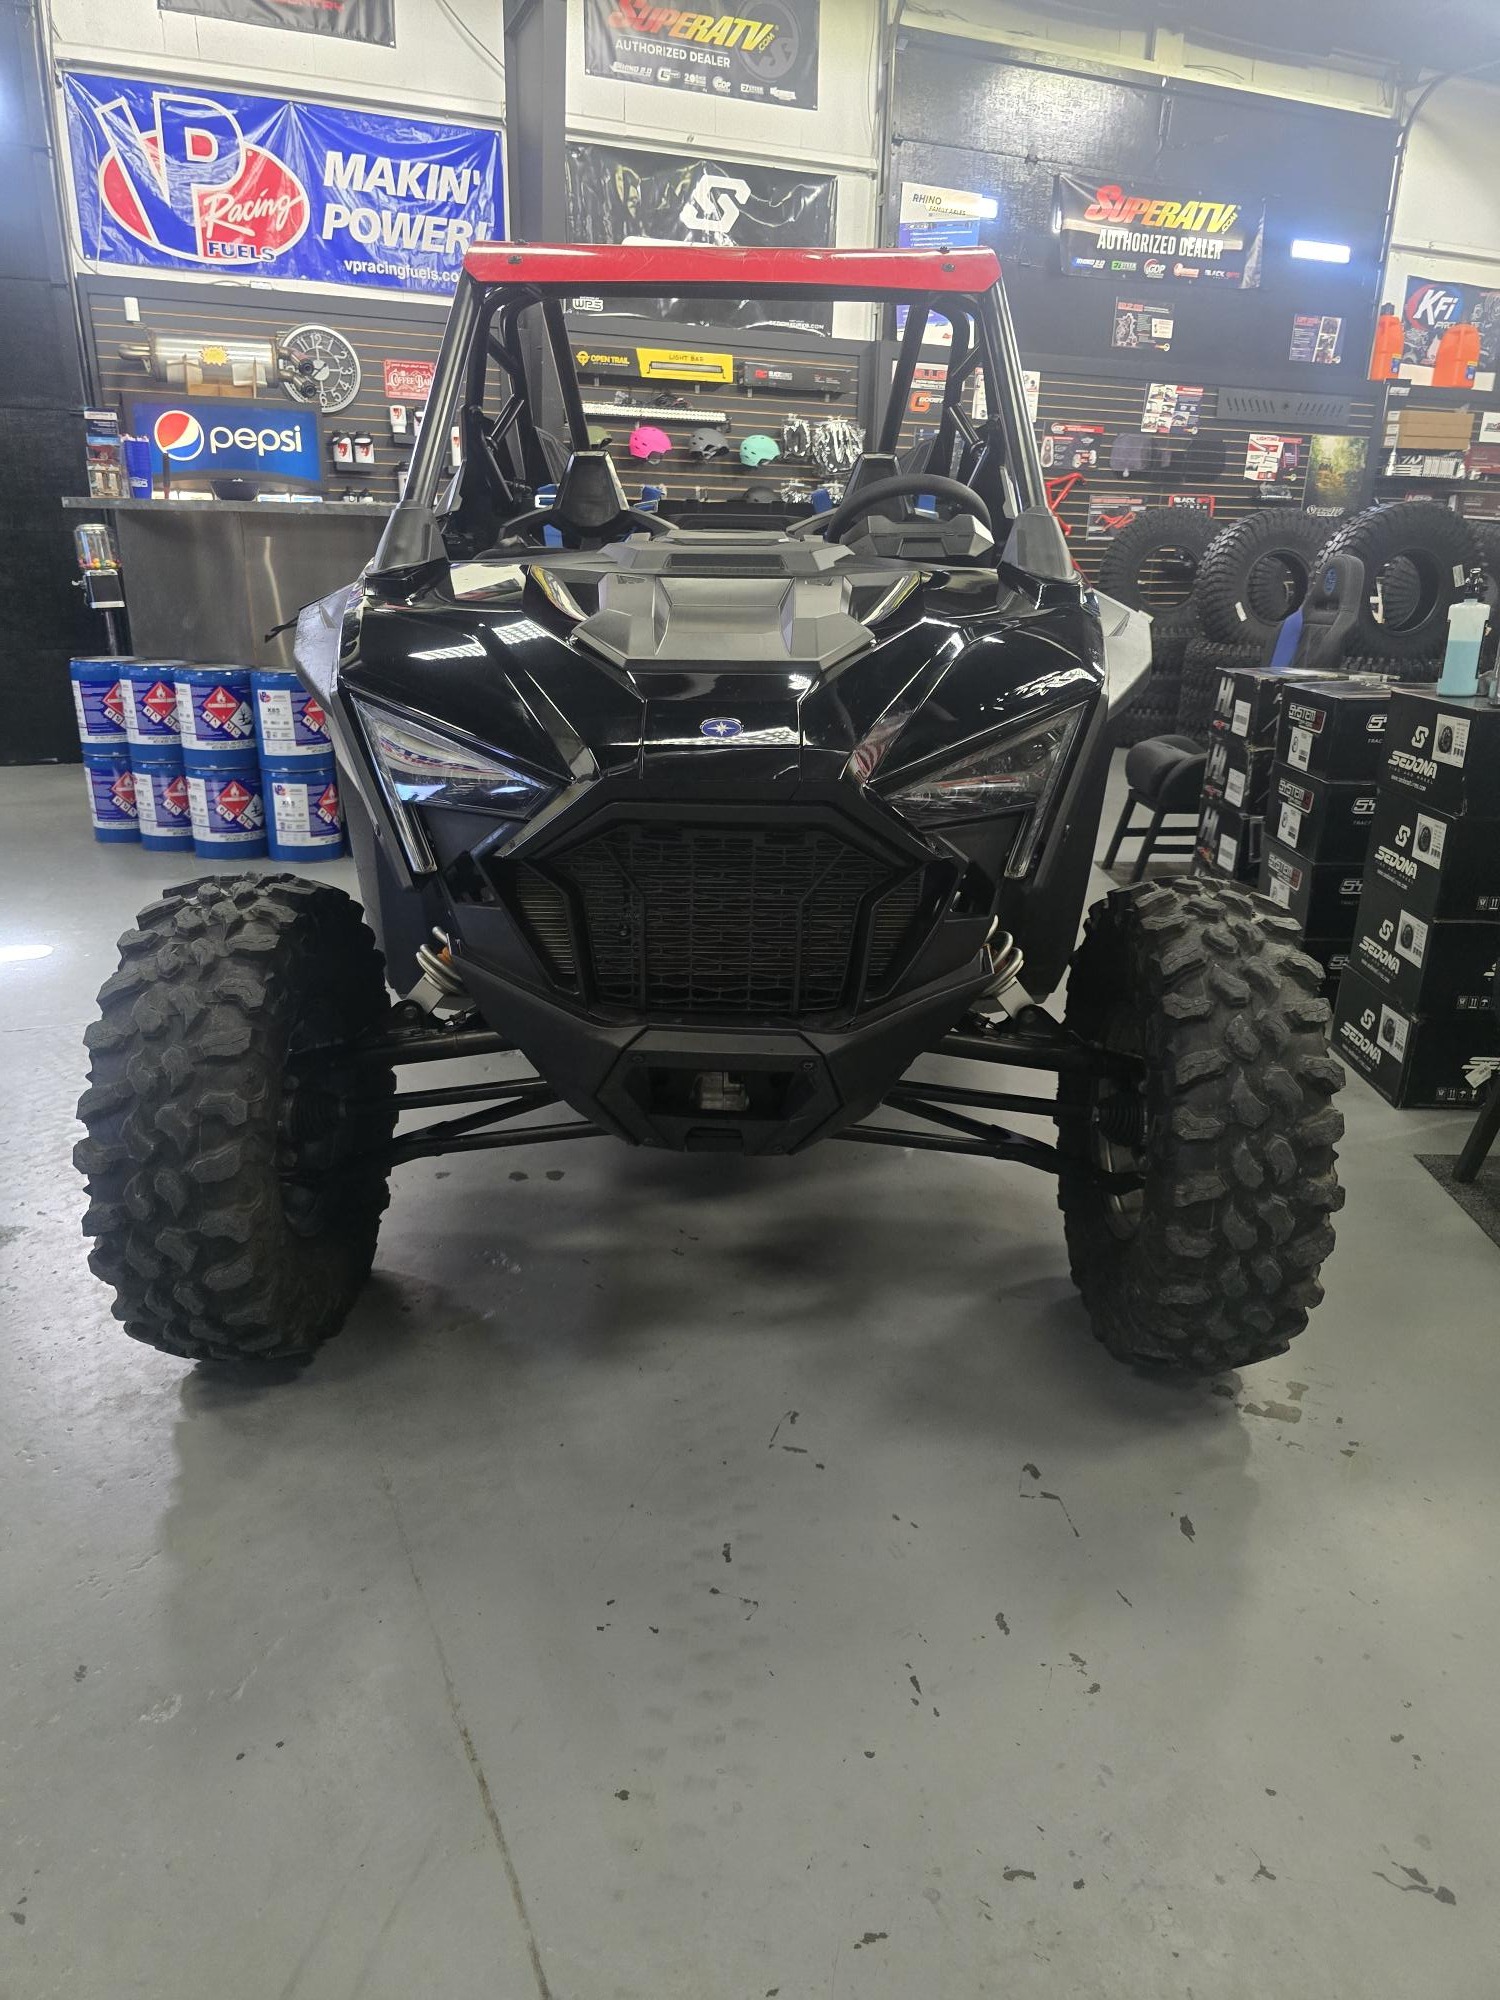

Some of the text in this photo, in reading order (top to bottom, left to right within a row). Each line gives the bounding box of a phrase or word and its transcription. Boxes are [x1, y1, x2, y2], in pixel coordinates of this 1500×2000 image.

[615, 39, 731, 68] AUTHORIZED DEALER
[324, 150, 480, 204] MAKIN'
[203, 188, 304, 239] Racing
[912, 193, 942, 205] RHINO
[207, 242, 276, 262] FUELS
[1097, 228, 1224, 260] AUTHORIZED DEALER
[344, 259, 461, 283] vpracingfuels.co
[573, 299, 603, 311] WPS
[310, 333, 322, 349] 12
[591, 354, 611, 363] OPEN
[612, 356, 630, 365] TRAIL
[210, 425, 302, 456] pepsi
[1388, 750, 1438, 780] SEDONA
[1374, 845, 1418, 880] SEDONA
[1359, 935, 1400, 975] SEDONA
[1340, 1021, 1382, 1065] SEDONA
